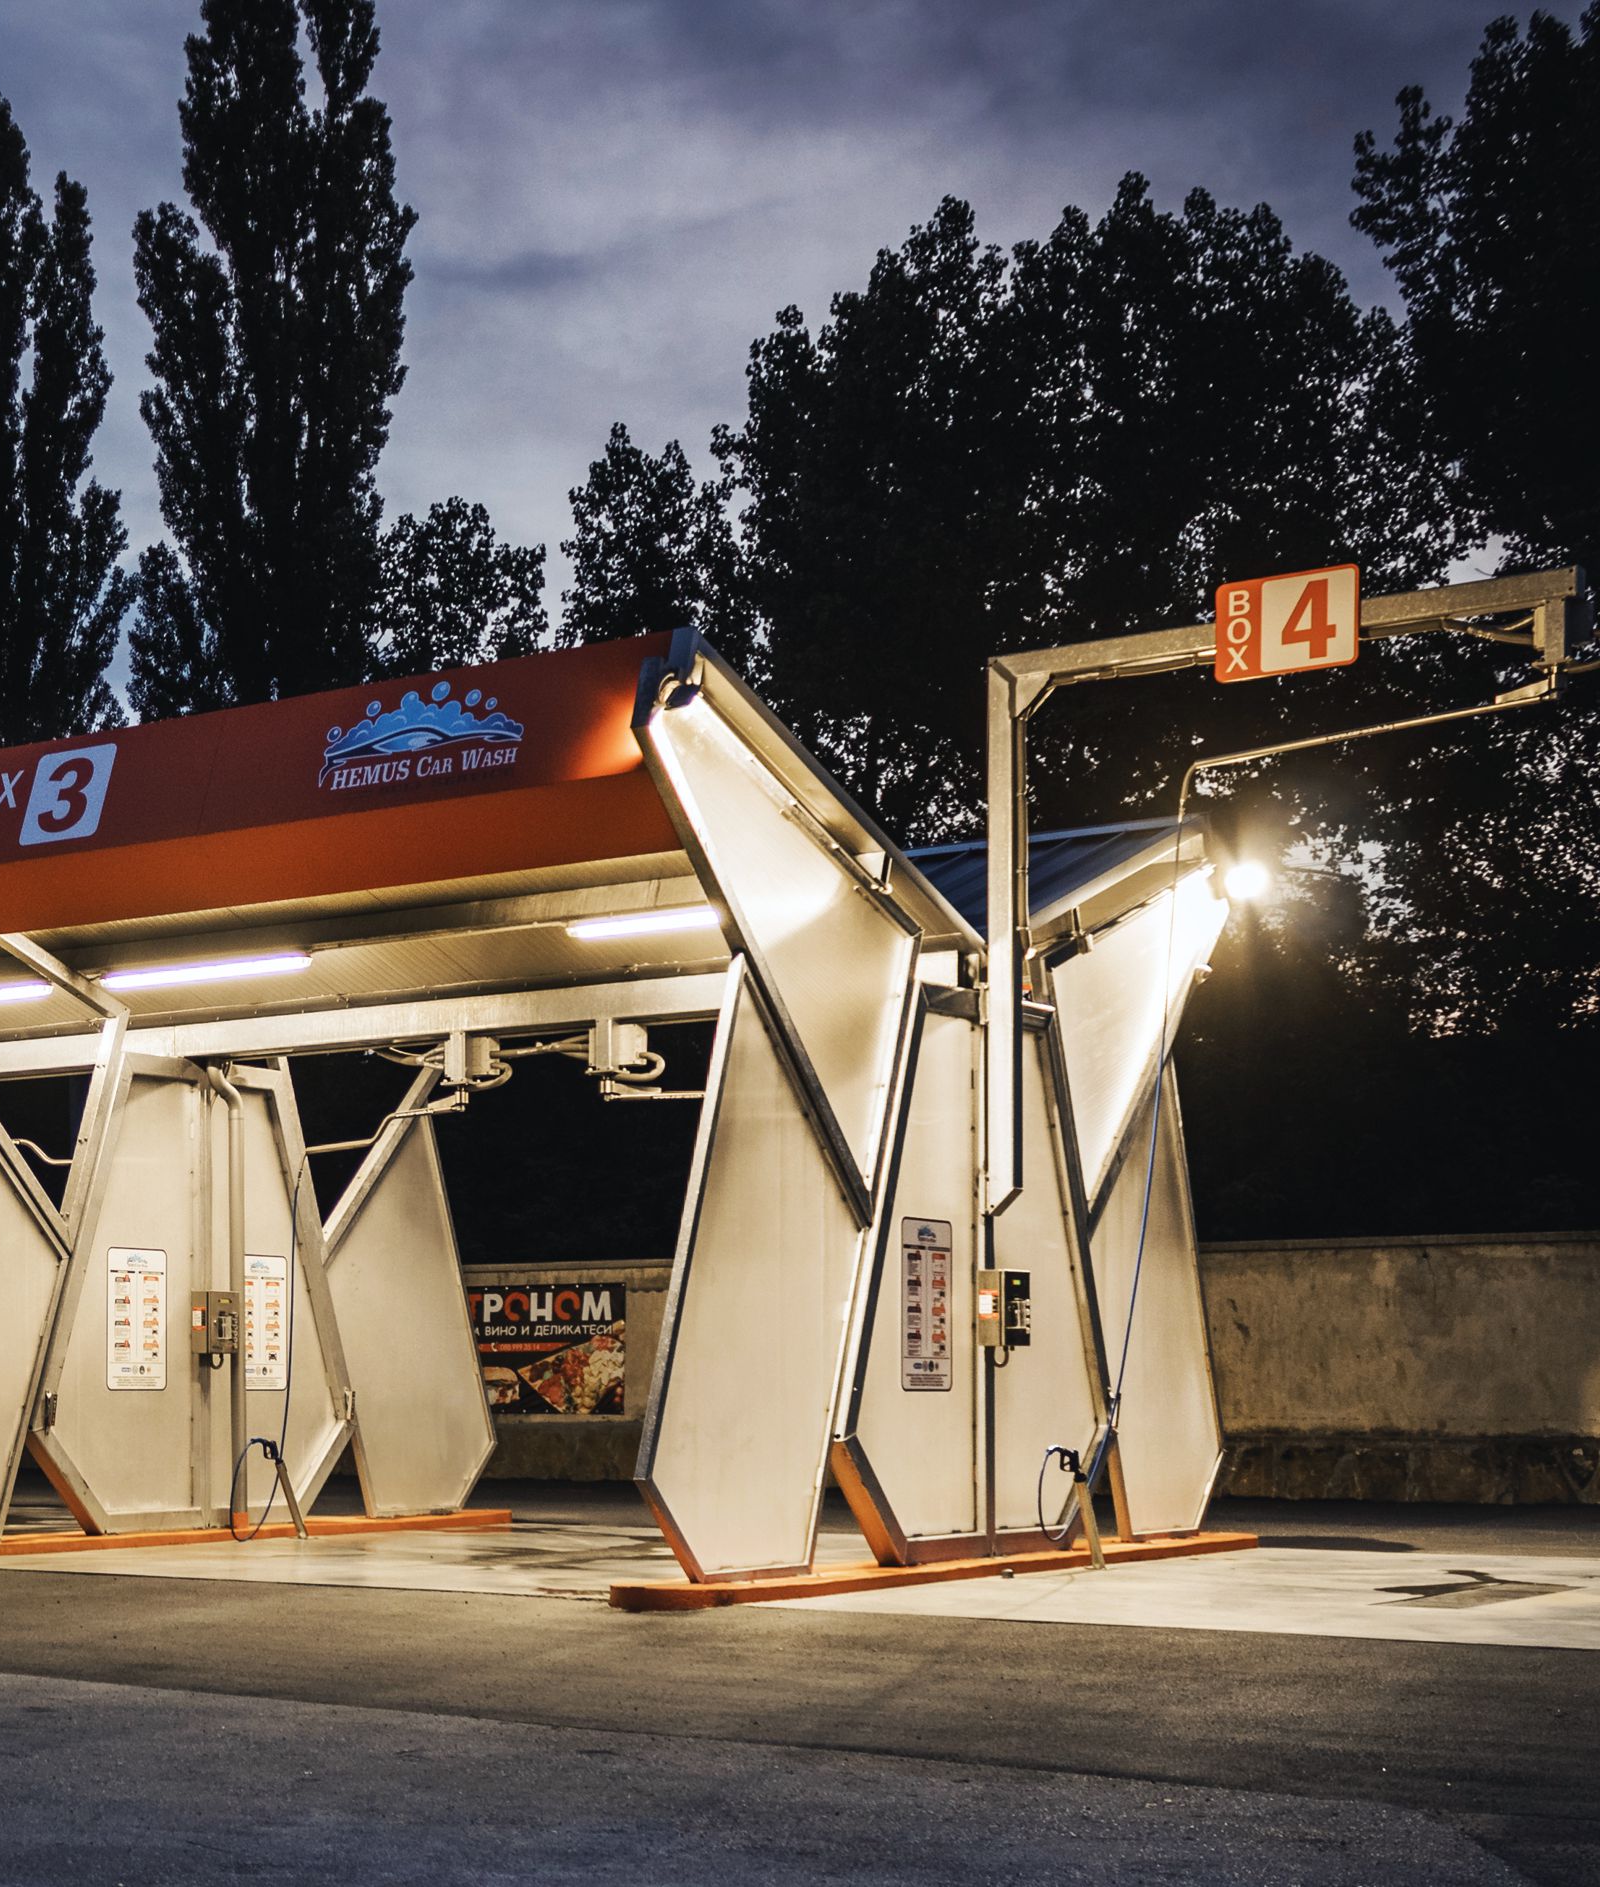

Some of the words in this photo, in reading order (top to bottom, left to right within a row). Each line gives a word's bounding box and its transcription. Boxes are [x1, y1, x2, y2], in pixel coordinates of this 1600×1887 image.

[1225, 590, 1252, 673] BOX
[1281, 578, 1336, 660] 4
[37, 758, 95, 833] 3
[330, 759, 410, 790] HEMUS
[485, 1326, 517, 1336] ВИНО
[521, 1326, 530, 1336] И
[534, 1324, 612, 1336] ДЕЛИКАТЕСИ
